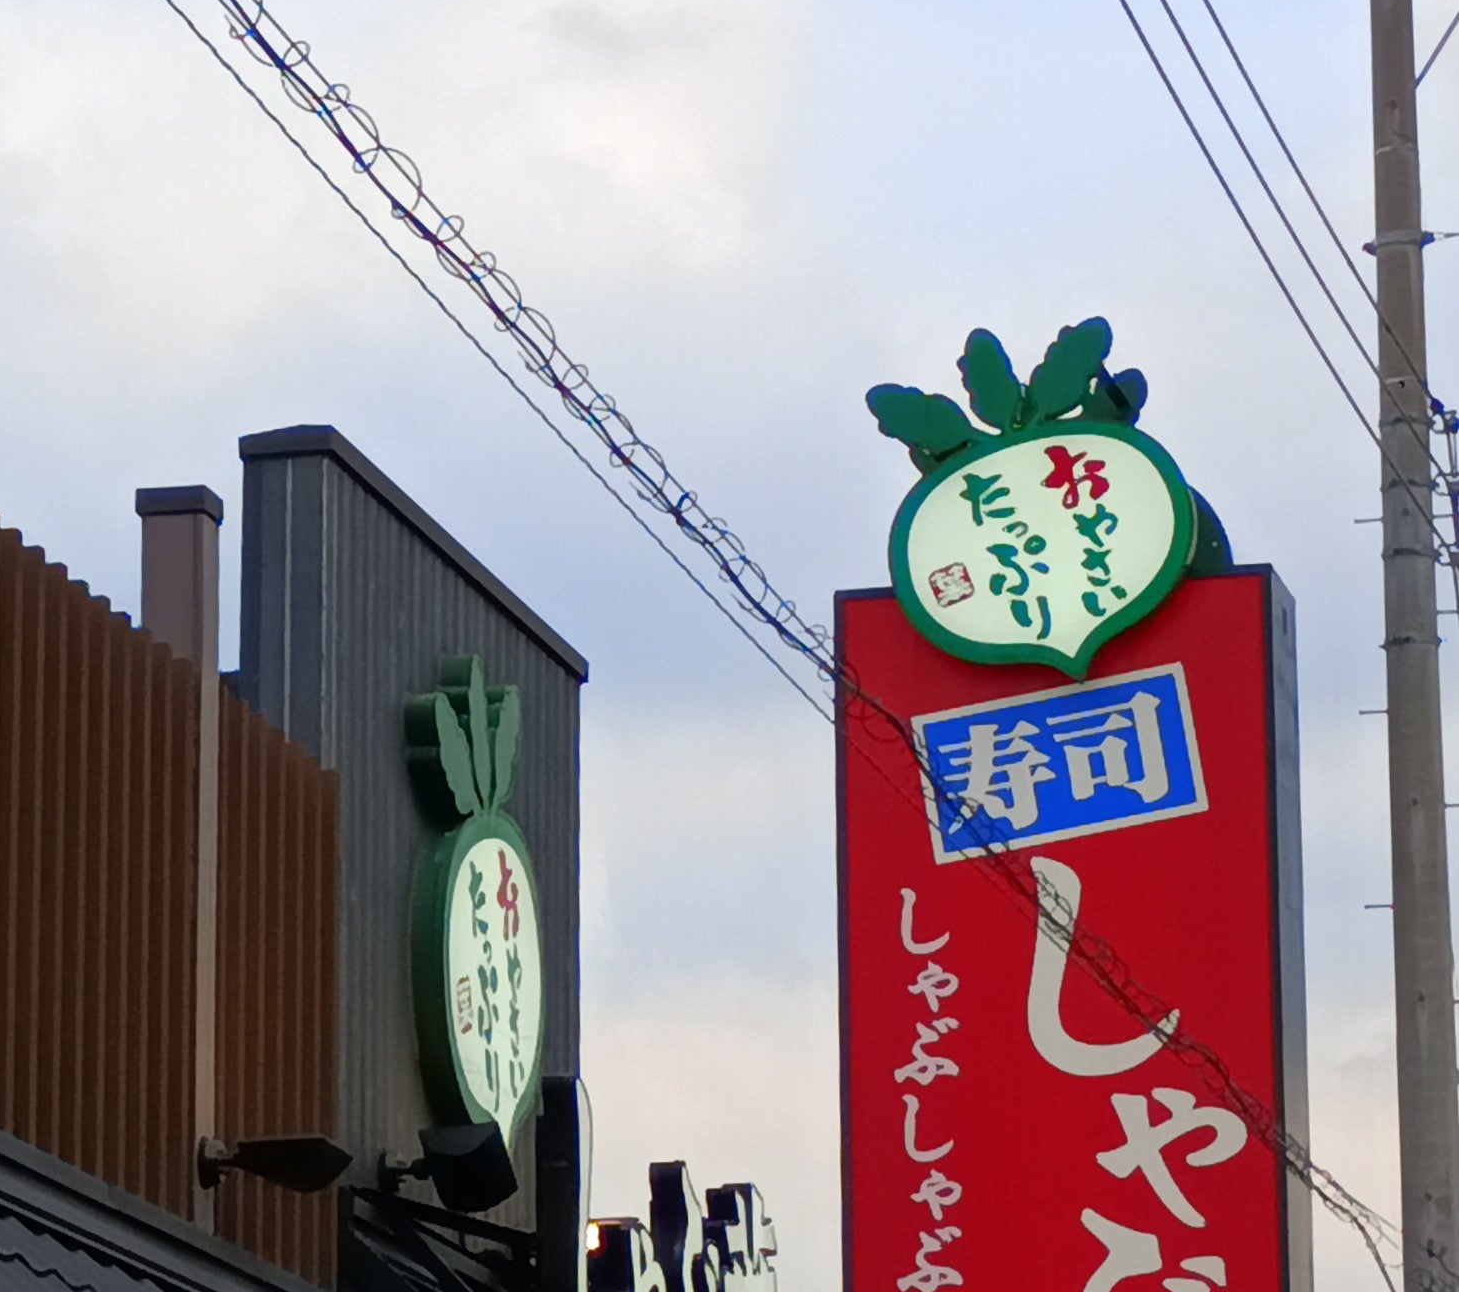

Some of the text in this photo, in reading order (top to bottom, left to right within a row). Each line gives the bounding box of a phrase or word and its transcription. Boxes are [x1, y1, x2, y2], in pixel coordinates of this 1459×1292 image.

[958, 472, 1052, 640] たっぷり
[1041, 445, 1128, 617] おやさい
[937, 690, 1161, 836] 寿司
